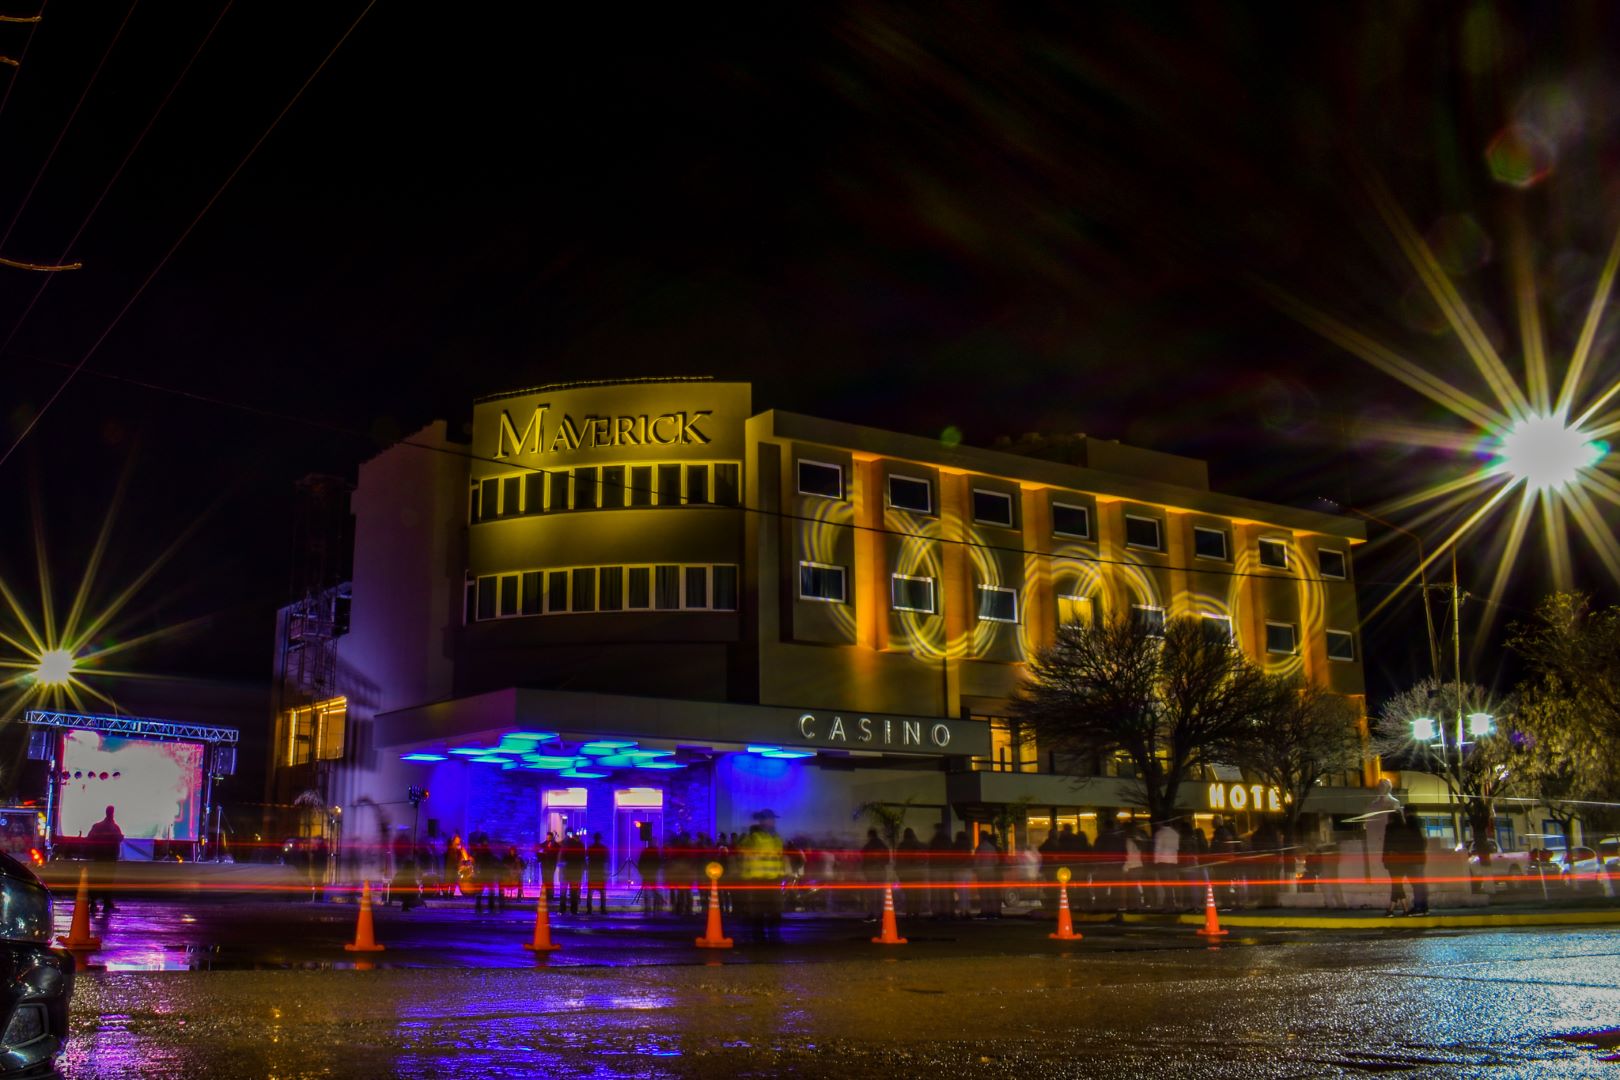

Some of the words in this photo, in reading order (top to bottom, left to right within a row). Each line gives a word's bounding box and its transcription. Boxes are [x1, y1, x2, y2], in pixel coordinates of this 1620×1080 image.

[494, 403, 712, 459] MAVERICK
[799, 714, 950, 747] CASINO
[1208, 783, 1293, 812] HOTE
